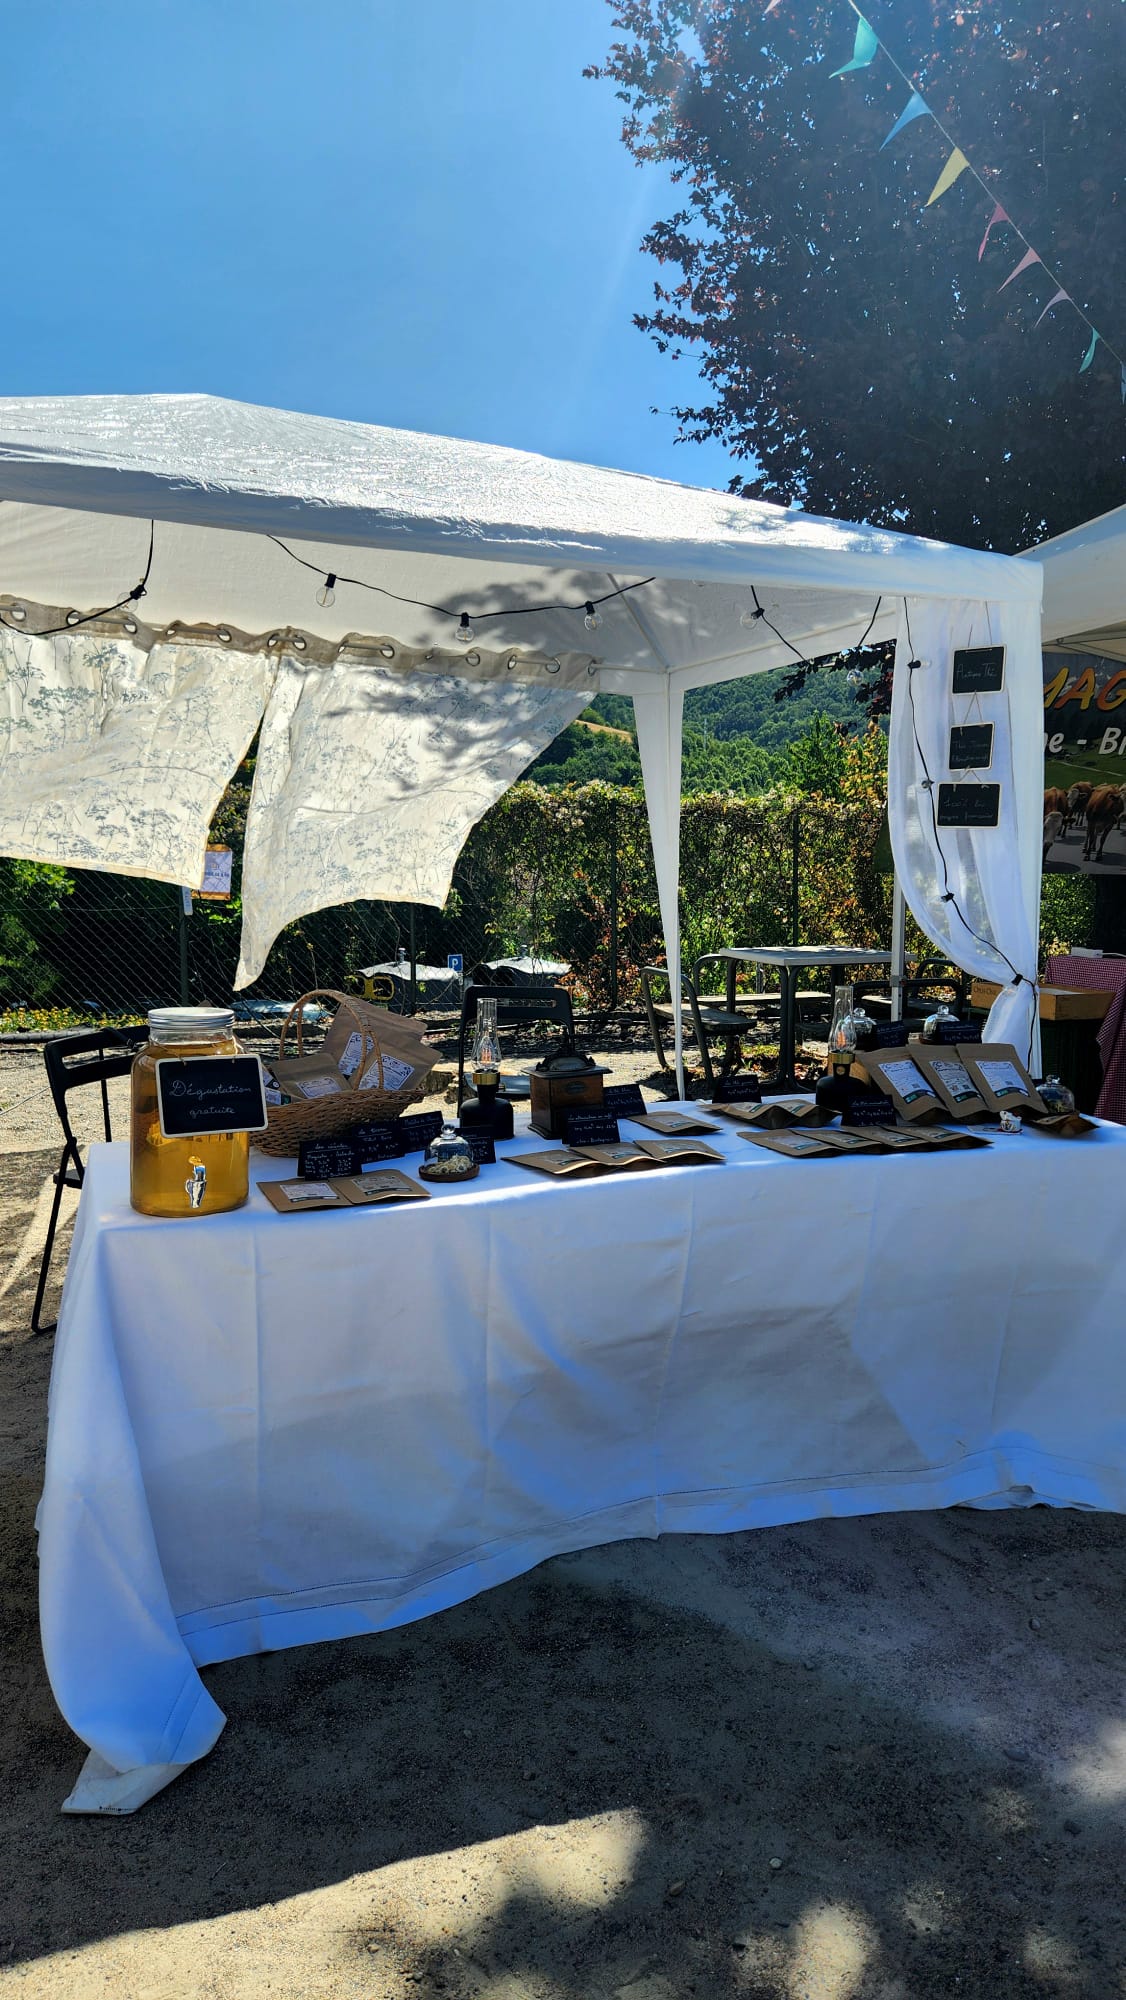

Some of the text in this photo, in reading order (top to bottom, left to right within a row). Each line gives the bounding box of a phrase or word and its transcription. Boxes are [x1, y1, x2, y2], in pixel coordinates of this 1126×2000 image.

[452, 958, 459, 969] P
[169, 1079, 252, 1100] Dégustation
[189, 1106, 236, 1120] gratuite
